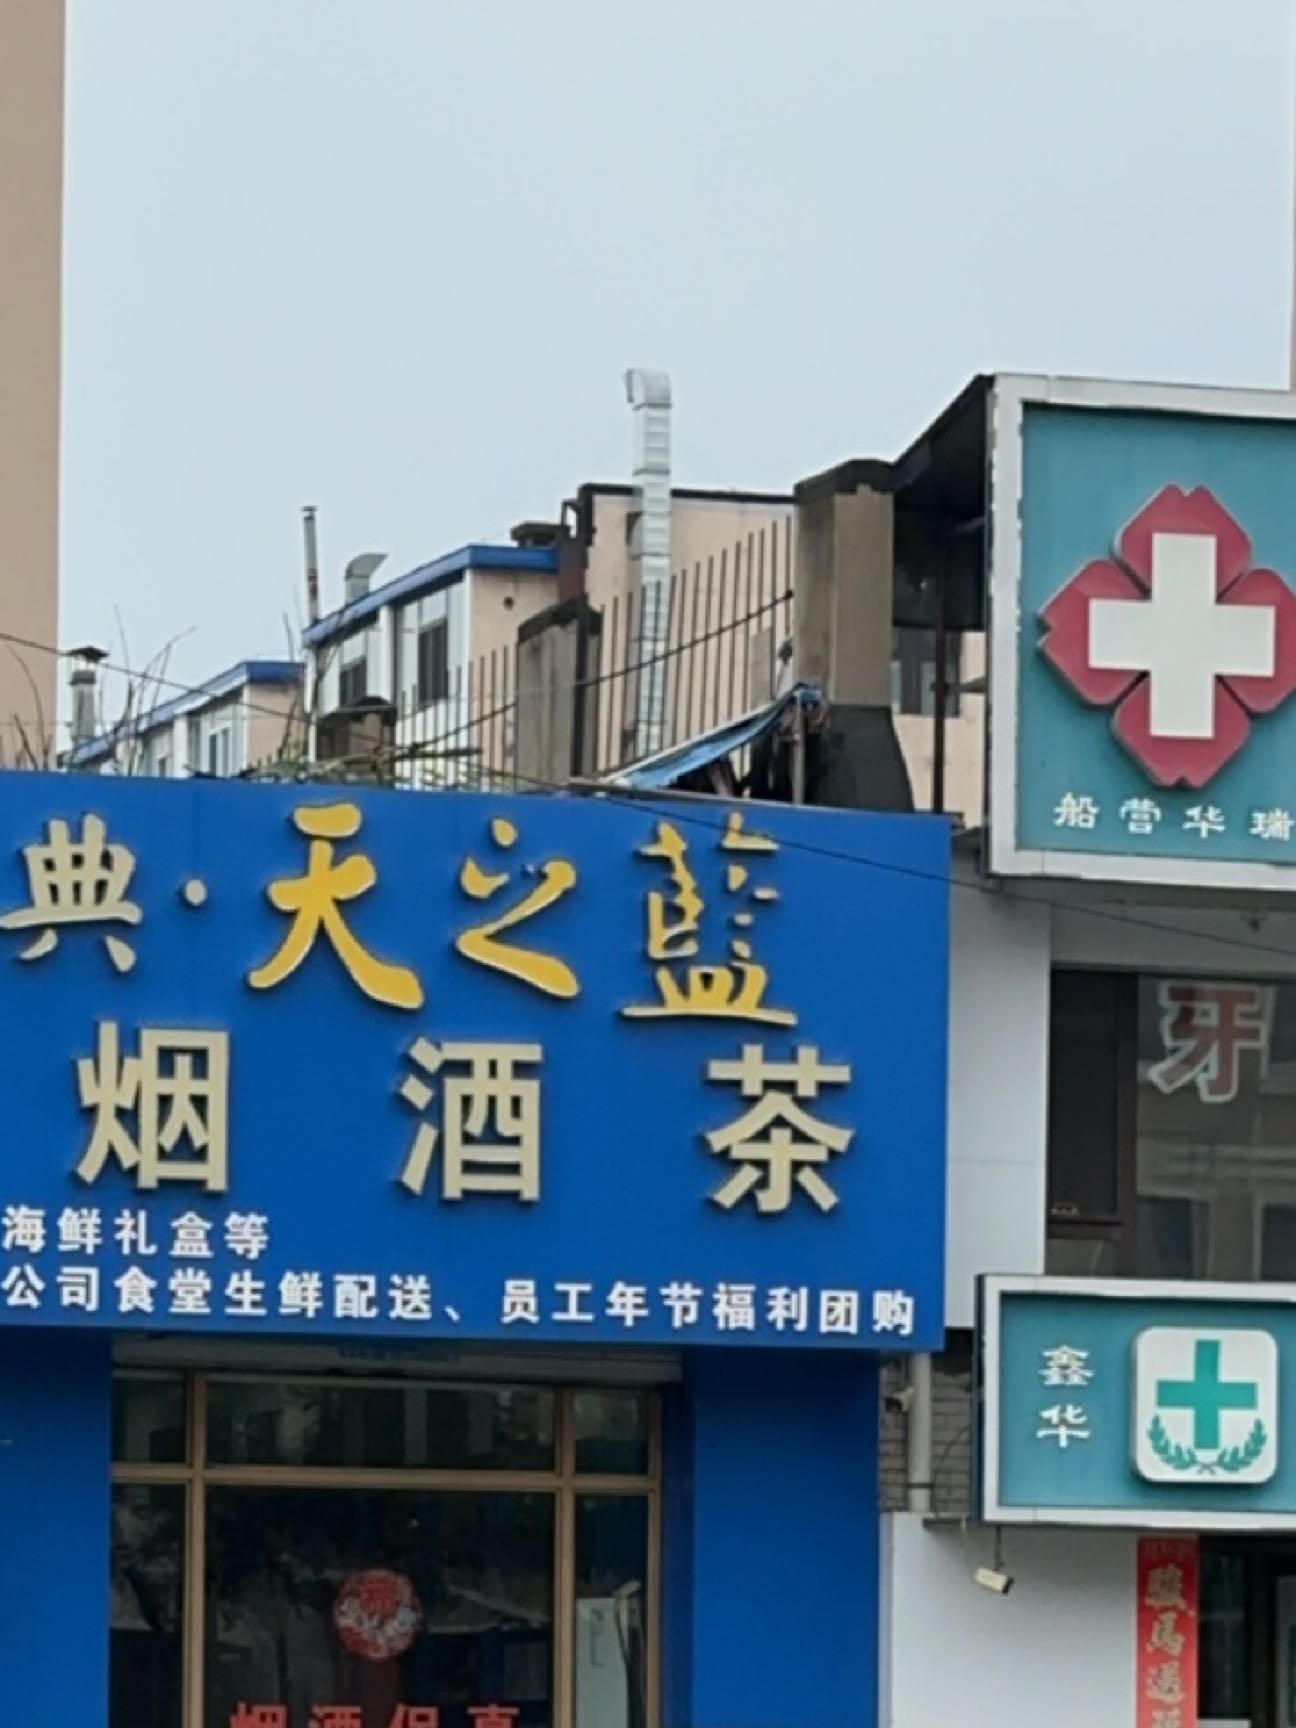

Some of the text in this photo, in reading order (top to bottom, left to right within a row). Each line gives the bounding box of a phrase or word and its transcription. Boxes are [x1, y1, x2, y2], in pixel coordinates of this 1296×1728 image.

[1053, 791, 1295, 841] 船营华瑞
[1036, 1345, 1094, 1448] 鑫华
